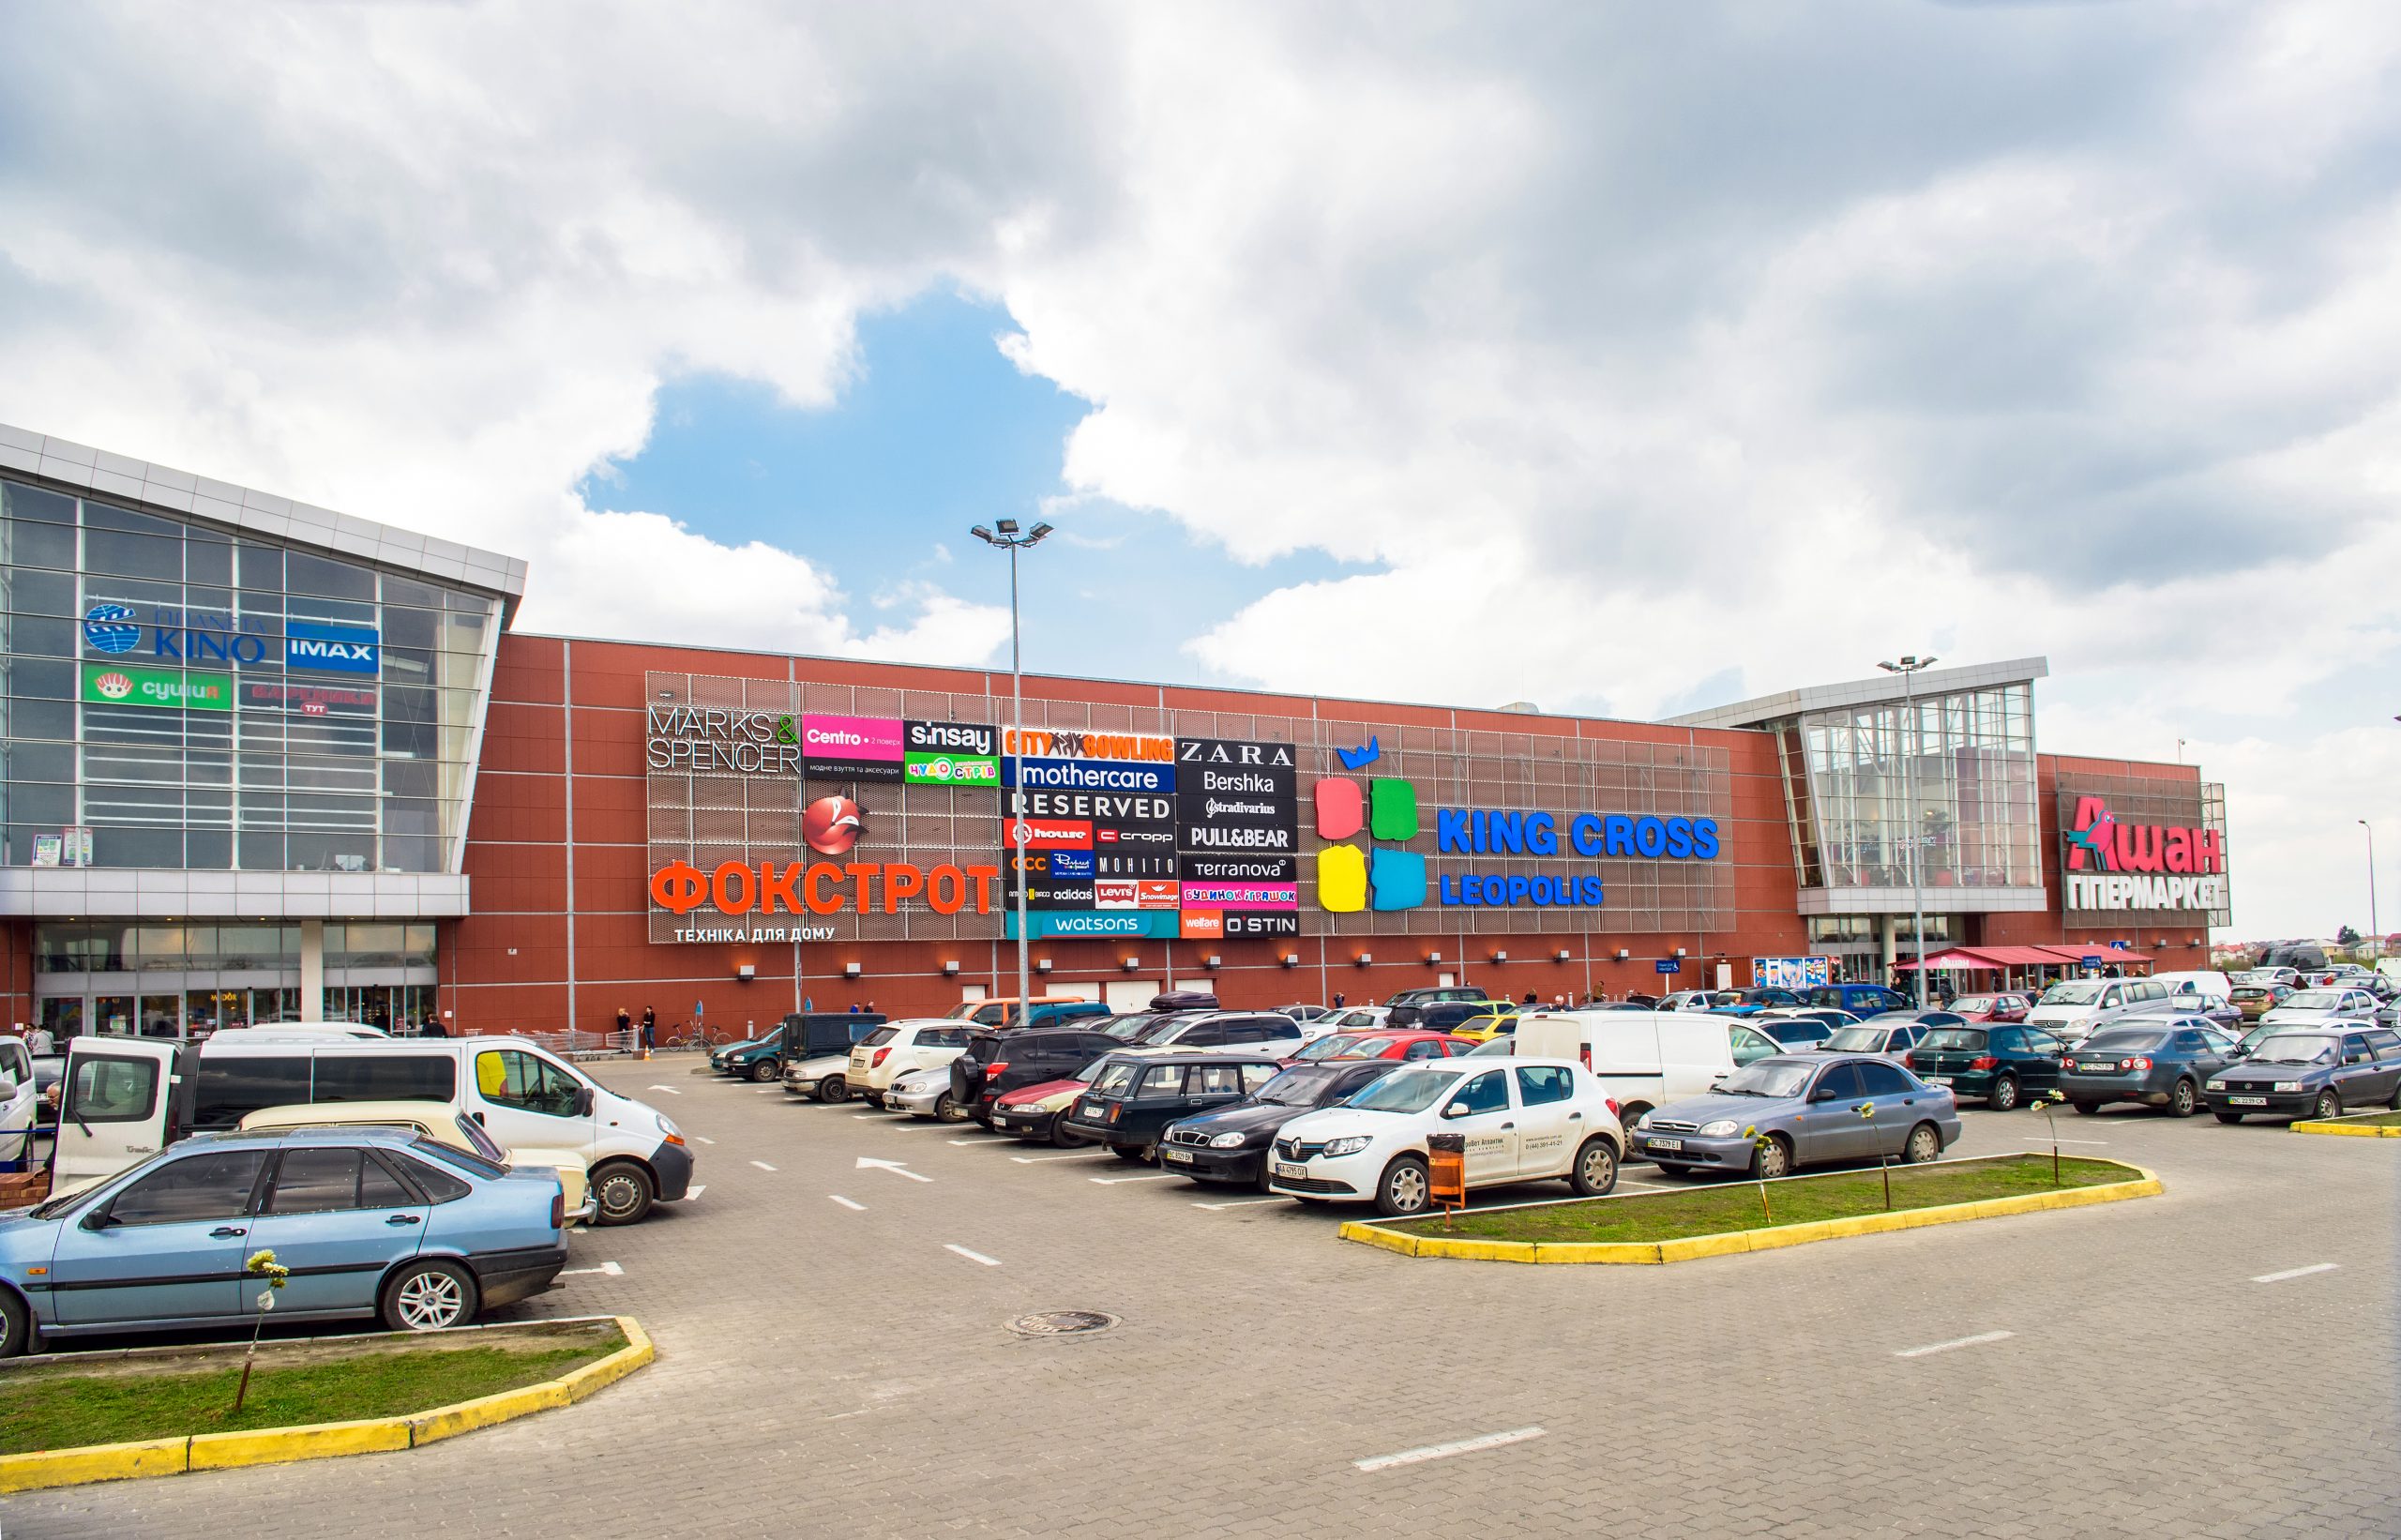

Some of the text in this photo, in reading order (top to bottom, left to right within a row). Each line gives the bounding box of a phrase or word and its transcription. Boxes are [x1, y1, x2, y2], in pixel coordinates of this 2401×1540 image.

[155, 627, 265, 663] KINO
[291, 639, 372, 661] IMAX
[305, 704, 325, 713] ТУТ
[648, 705, 800, 745] MARKS &
[807, 729, 861, 746] Centro
[877, 738, 900, 747] поверх
[911, 721, 990, 755] sinsay
[1005, 730, 1173, 762] CITY BOWLING
[648, 738, 800, 774] SPENCER
[1181, 742, 1294, 766] ZARA
[834, 765, 855, 774] взуття
[1022, 762, 1158, 789] mothercare
[1203, 771, 1275, 793] Bershka
[1011, 793, 1170, 819] RESERVED
[1034, 828, 1086, 839] house
[1120, 833, 1173, 842] cropp
[1191, 827, 1289, 848] PULL&BEAR
[1437, 808, 1720, 860] KING CROSS
[1099, 857, 1173, 873] MOHITO
[651, 860, 999, 915] ФОКСТРОТ
[1053, 888, 1094, 900] adidas
[1184, 889, 1241, 901] БУДИНОК
[1440, 874, 1604, 906] LEOPOLIS
[2066, 874, 2222, 910] ГІПЕРМАРКЕТ
[1055, 916, 1138, 931] watsons
[1185, 917, 1219, 928] welfare
[674, 927, 835, 943] ТЕХНІКА ДЛЯ ДОМУ
